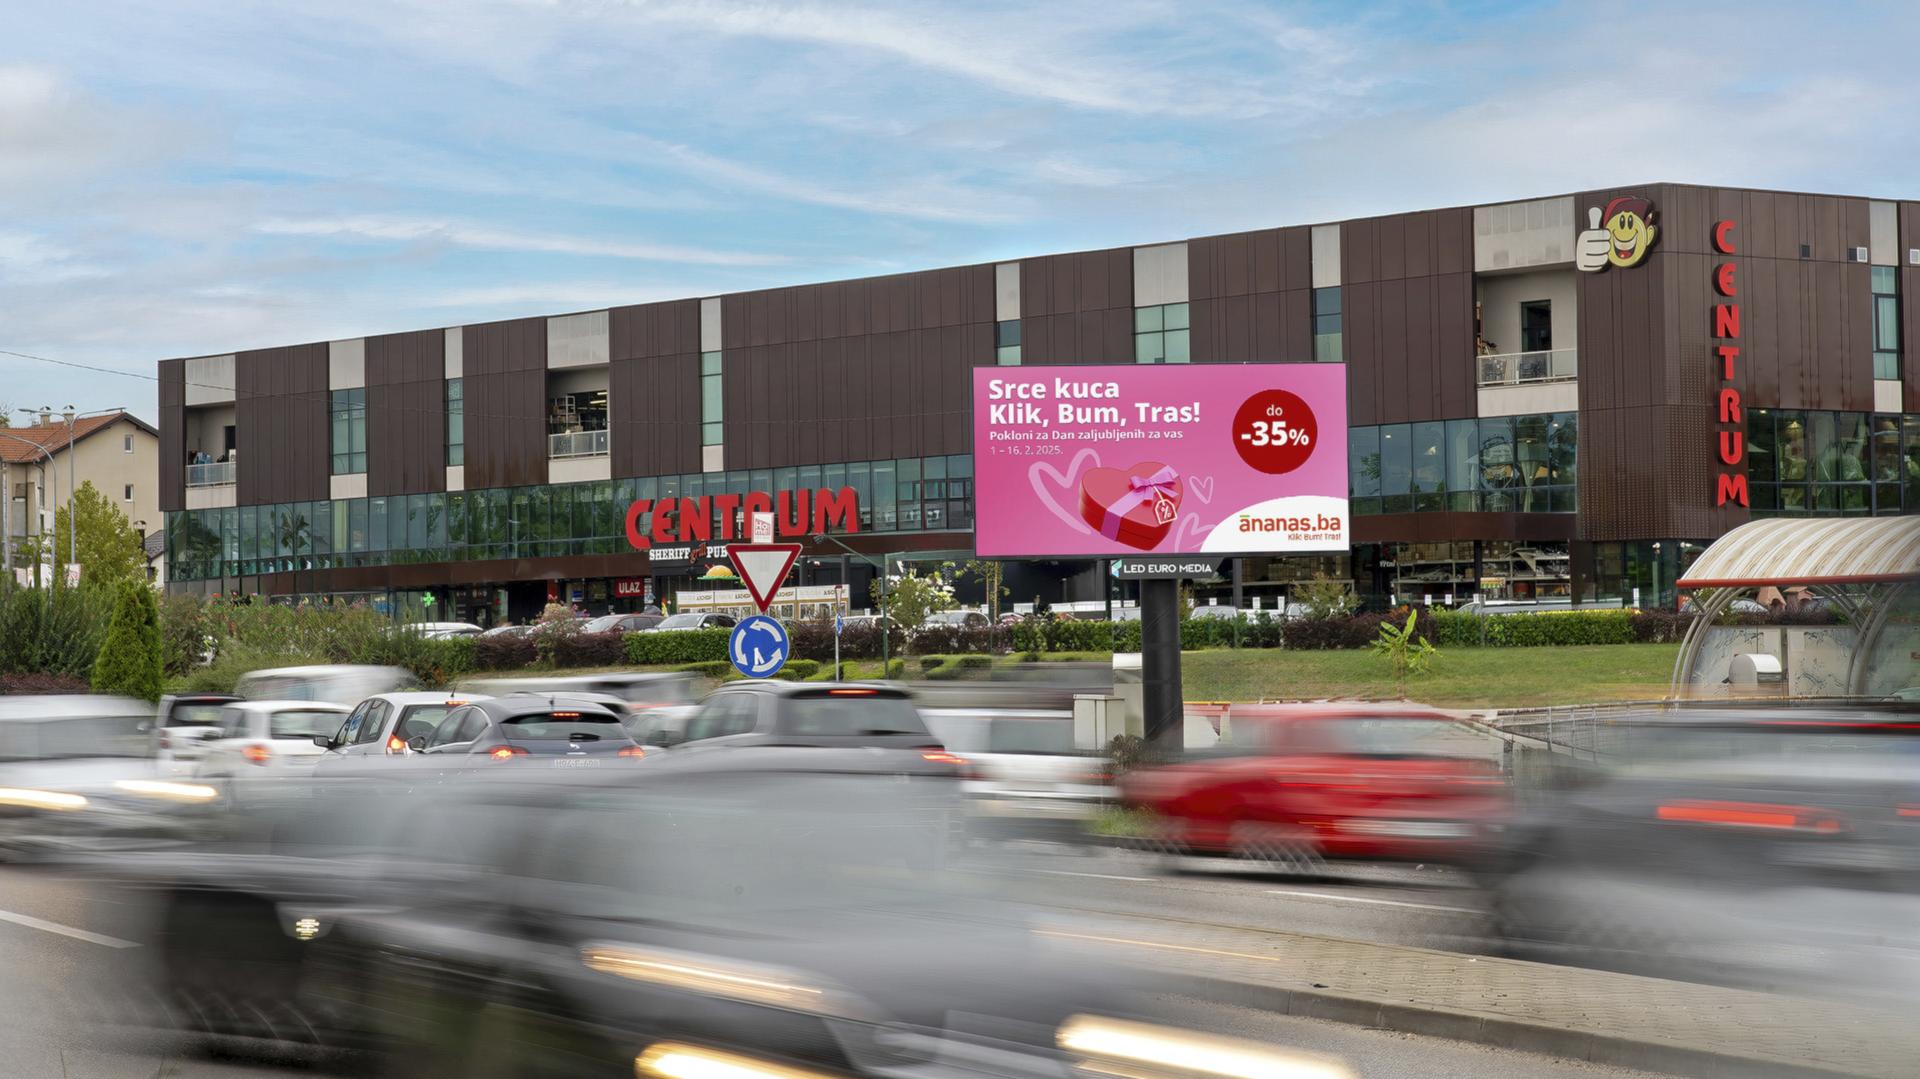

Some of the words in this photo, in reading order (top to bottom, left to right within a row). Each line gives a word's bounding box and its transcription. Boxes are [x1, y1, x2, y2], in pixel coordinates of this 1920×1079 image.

[1713, 220, 1749, 508] CENTRUM
[988, 379, 1046, 400] Srce
[1054, 377, 1120, 399] kuca
[990, 403, 1050, 428] Klik,
[1058, 403, 1127, 427] Bum,
[1134, 401, 1201, 423] Tras!
[1266, 404, 1283, 416] do
[990, 430, 1033, 441] Pokloni
[1036, 432, 1049, 440] za
[1052, 430, 1075, 440] Dan
[1077, 429, 1145, 442] zaljubljenih
[1148, 431, 1161, 439] za
[1163, 430, 1184, 439] vas
[1241, 421, 1310, 446] -35%
[1008, 446, 1022, 456] 16.
[1025, 445, 1034, 455] 2.
[1036, 445, 1064, 455] 2025.
[625, 487, 860, 550] CENTRUM
[649, 547, 691, 560] SHERIFF
[1123, 564, 1146, 573] LED
[1148, 564, 1176, 573] EURO
[1179, 564, 1212, 573] MEDIA
[618, 582, 641, 593] ULAZ
